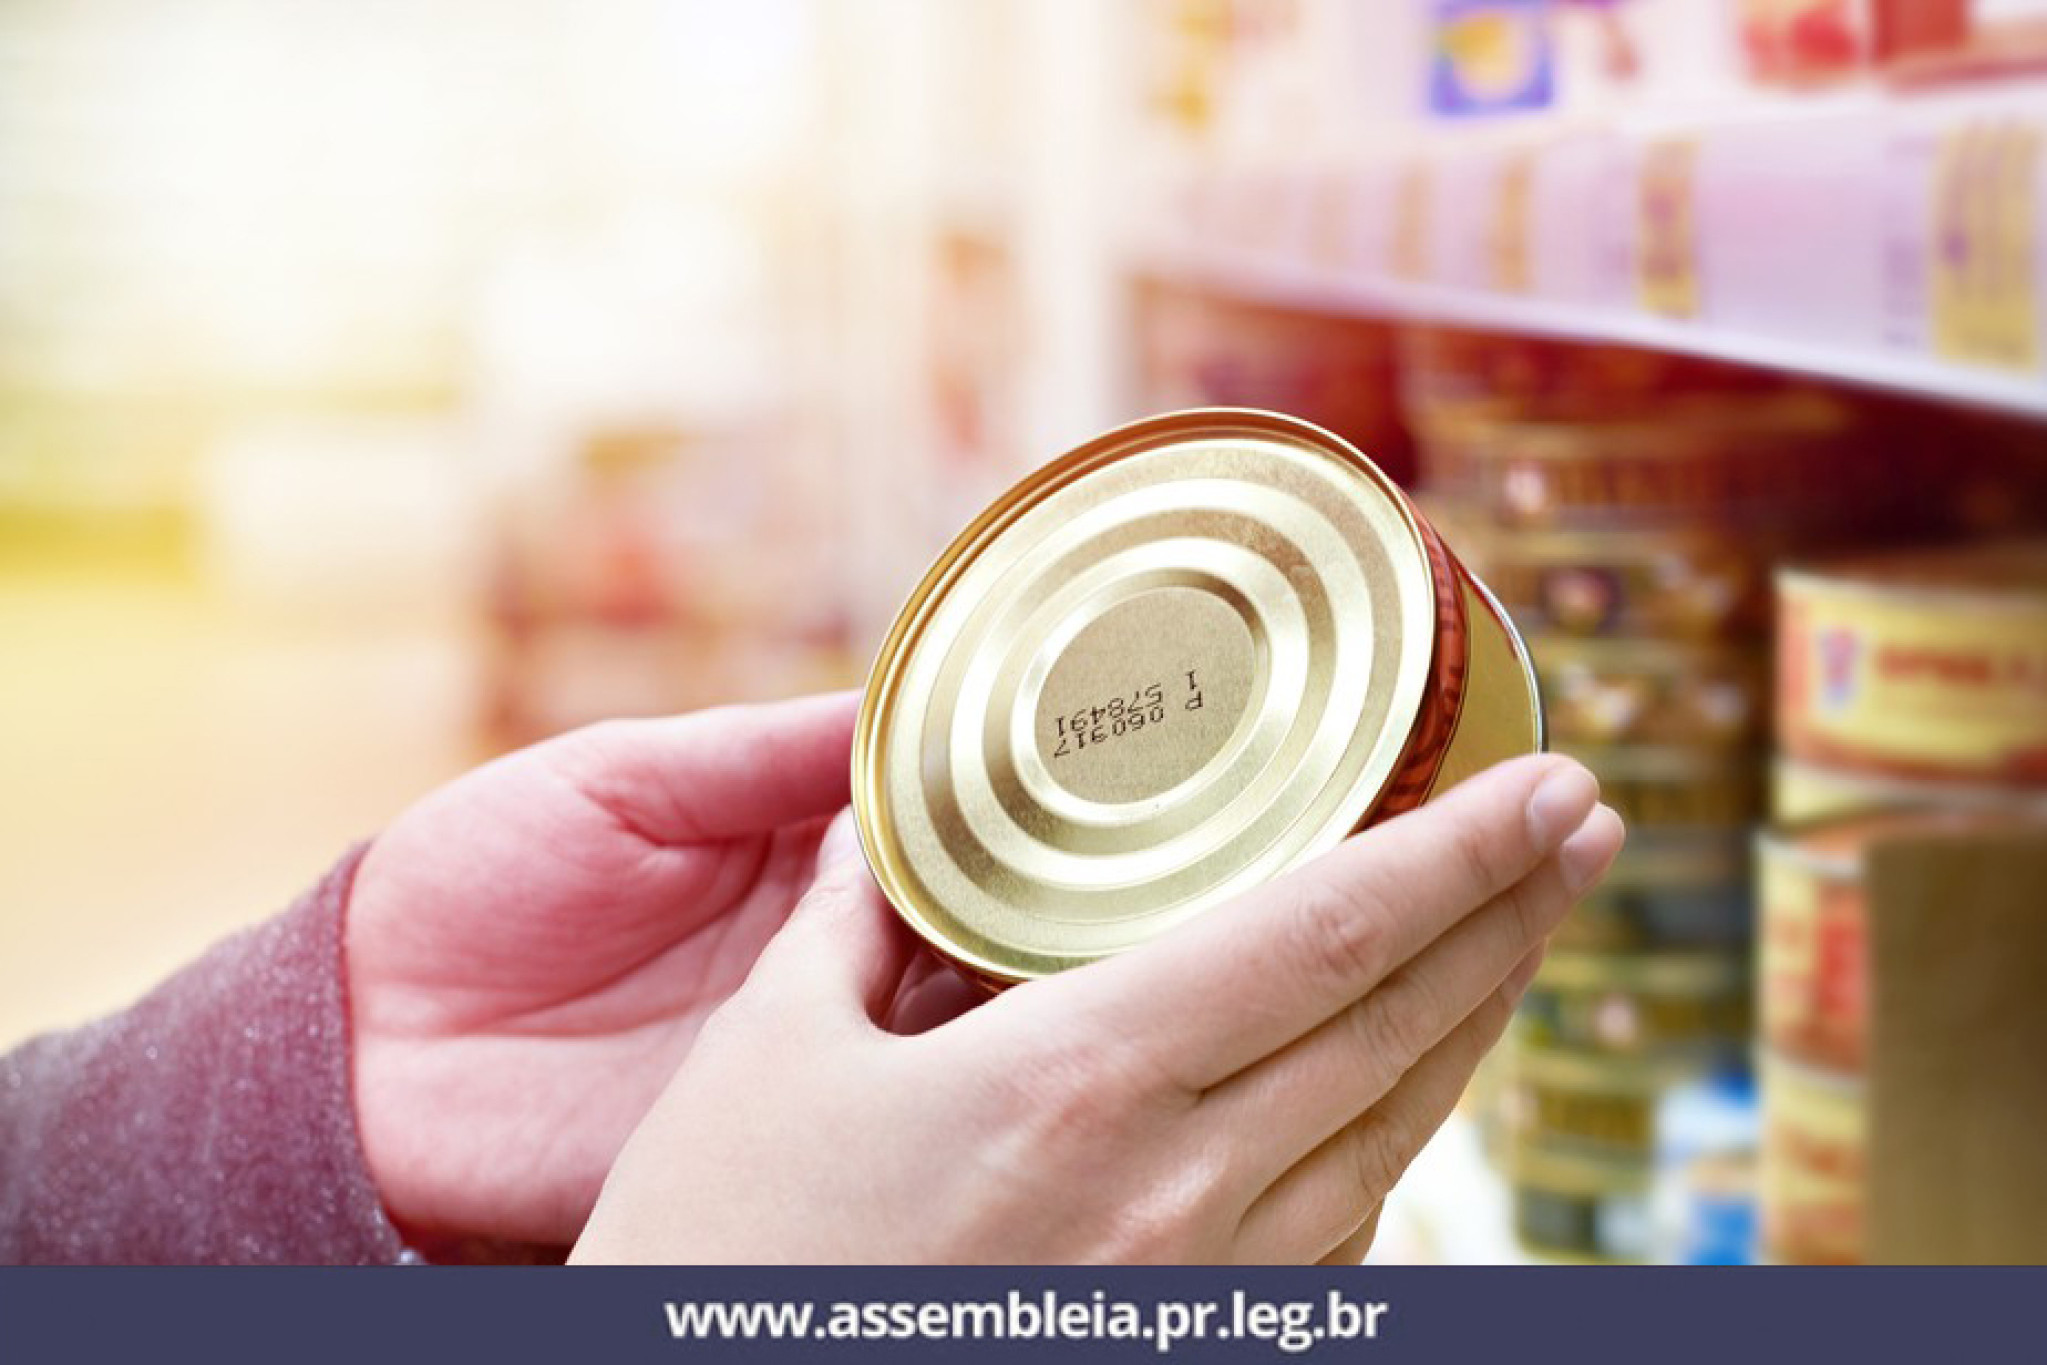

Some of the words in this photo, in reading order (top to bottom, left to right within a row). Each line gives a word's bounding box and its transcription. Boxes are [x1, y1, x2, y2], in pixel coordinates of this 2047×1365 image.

[1184, 669, 1198, 690] 1
[1055, 682, 1164, 737] 578491
[1184, 690, 1203, 711] P
[1054, 706, 1164, 758] 060917
